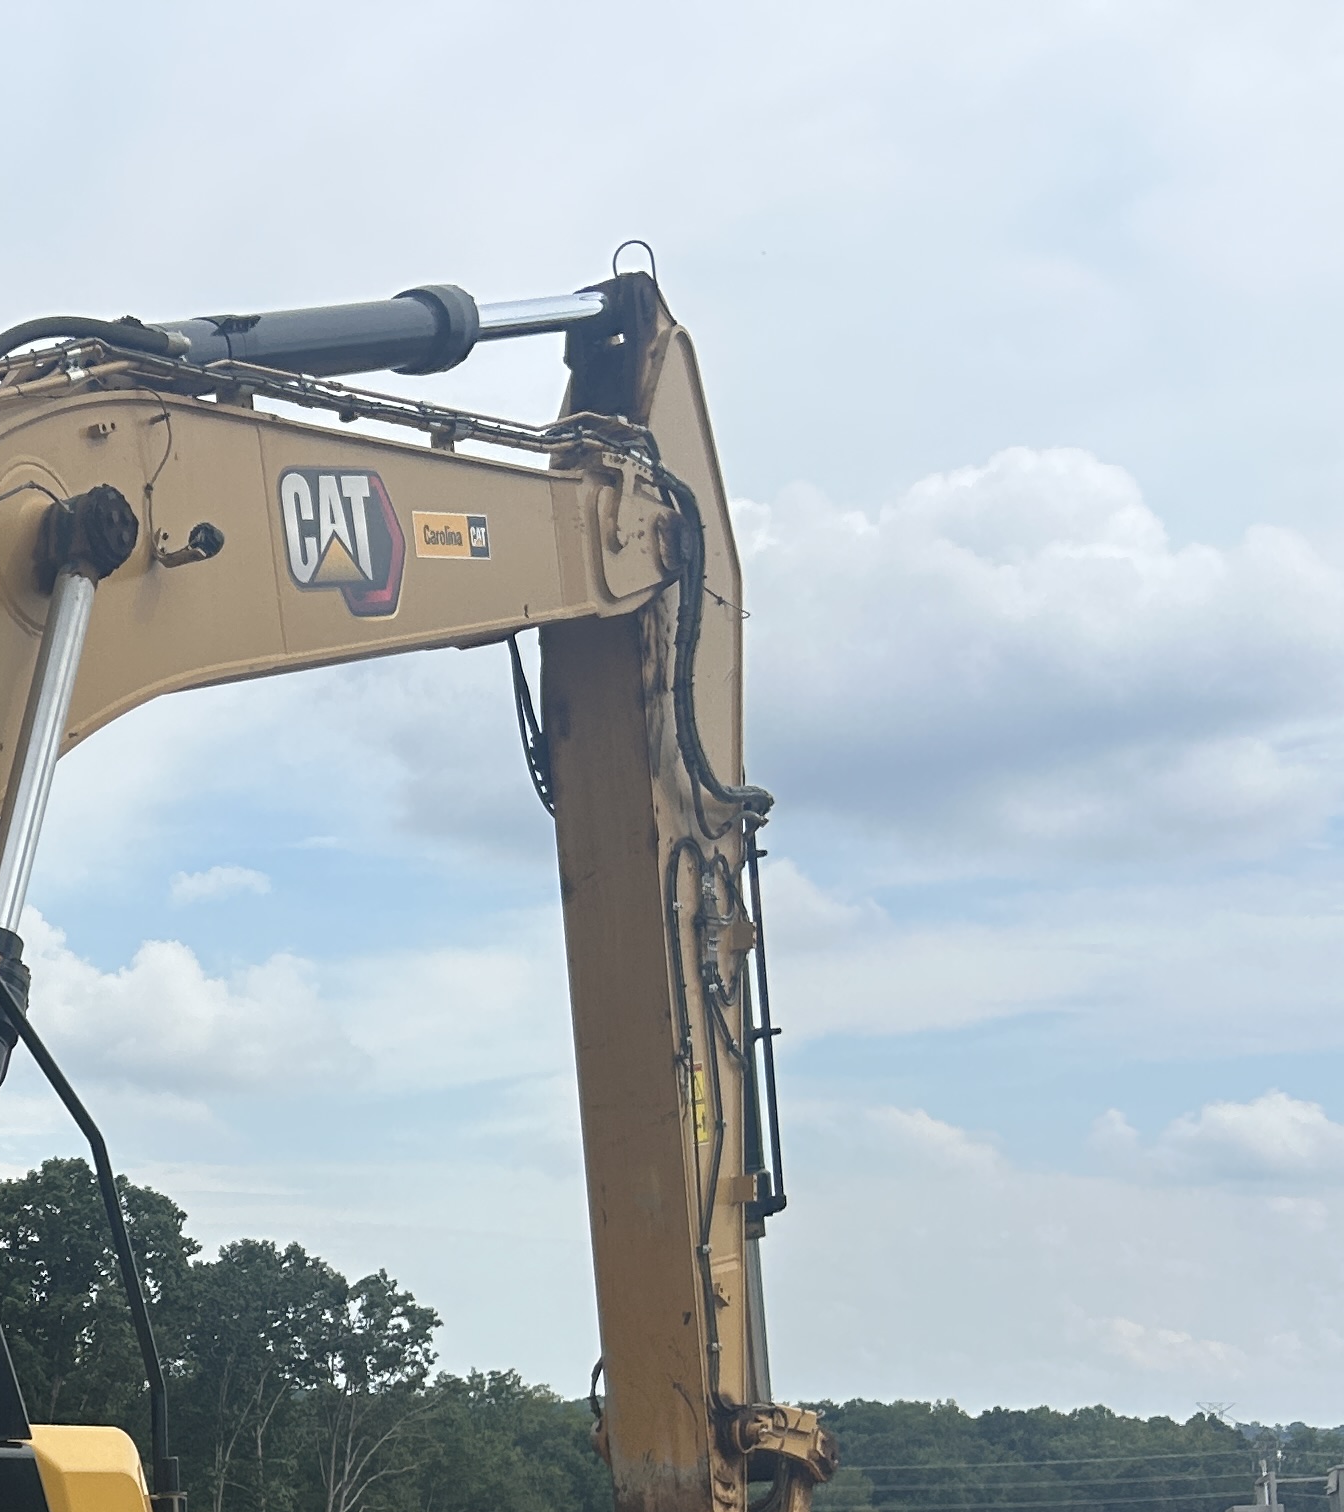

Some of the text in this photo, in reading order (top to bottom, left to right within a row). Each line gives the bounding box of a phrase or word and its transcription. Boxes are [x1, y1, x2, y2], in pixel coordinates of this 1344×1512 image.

[281, 473, 373, 583] CAT
[423, 524, 486, 548] Carolina CAT
